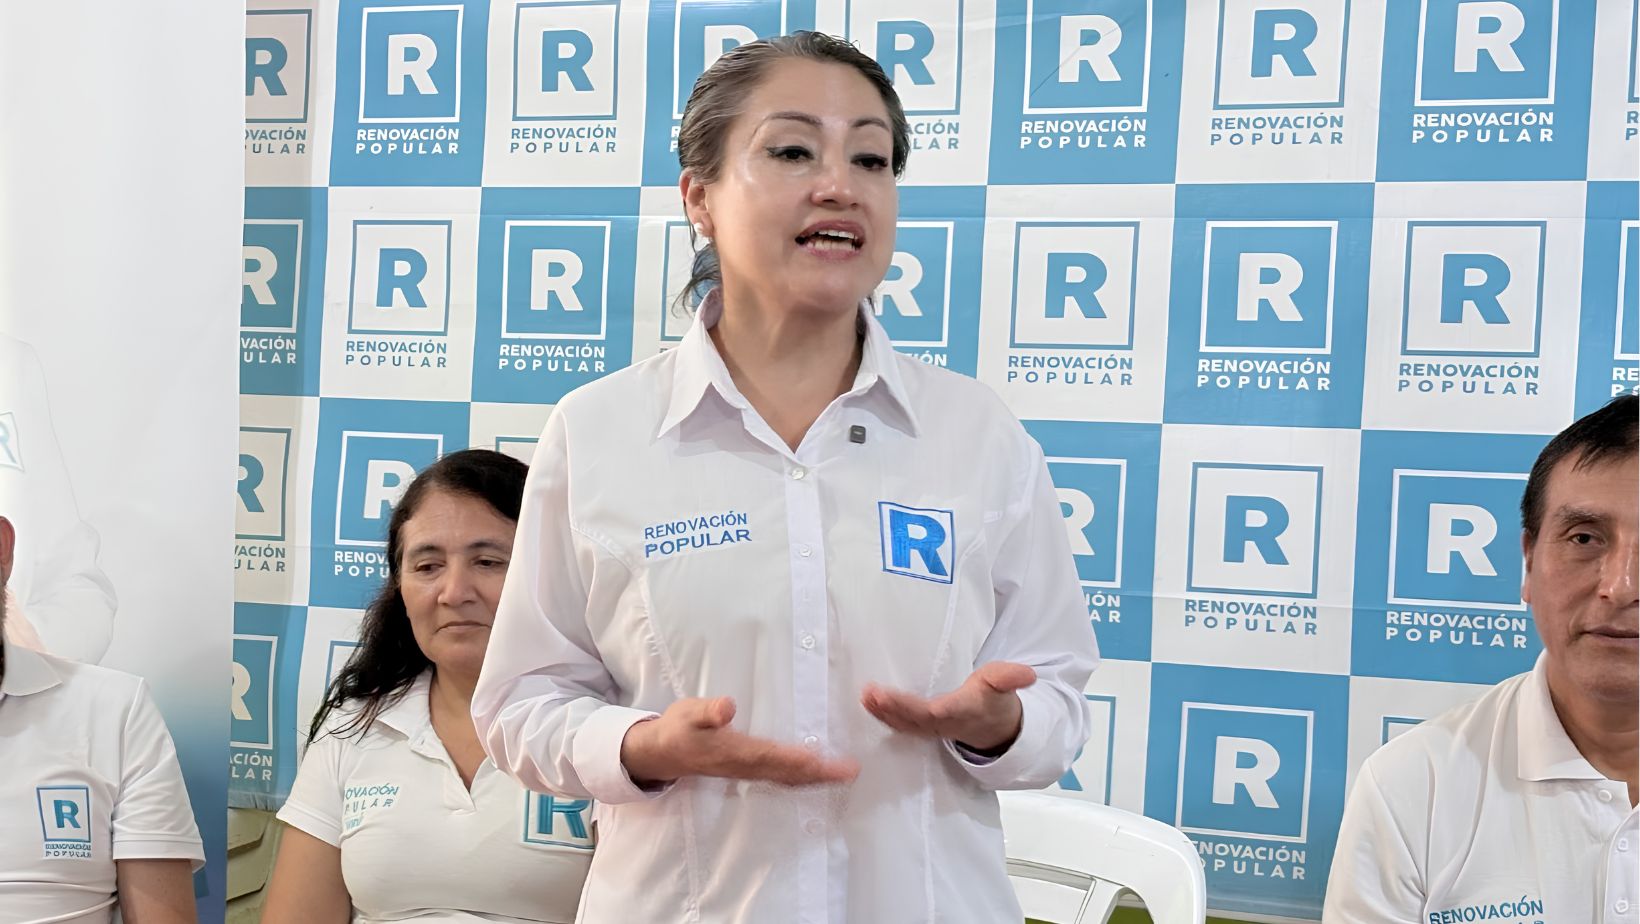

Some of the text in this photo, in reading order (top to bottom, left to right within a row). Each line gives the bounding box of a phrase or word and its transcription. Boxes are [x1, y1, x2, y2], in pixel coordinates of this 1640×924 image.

[1250, 8, 1319, 78] R
[1454, 1, 1526, 73] R
[877, 19, 936, 86] R
[1058, 14, 1123, 83] R
[245, 37, 288, 96] R
[387, 33, 439, 95] R
[541, 29, 595, 93] R
[1020, 116, 1147, 134] RENOVACIÓN
[1211, 112, 1344, 131] RENOVACIÓN
[1412, 108, 1554, 128] RENOVACIÓN
[357, 126, 460, 141] RENOVACIÓN
[511, 124, 618, 140] RENOVACIÓN
[1020, 135, 1146, 149] POPULAR
[1210, 131, 1343, 146] POPULAR
[1412, 128, 1554, 144] POPULAR
[245, 143, 306, 154] ULAR
[356, 142, 460, 155] POPULAR
[510, 140, 617, 154] POPULAR
[375, 247, 428, 309] R
[530, 248, 584, 312] R
[875, 251, 924, 318] R
[1045, 252, 1108, 319] R
[1236, 252, 1304, 322] R
[1440, 253, 1511, 325] R
[346, 338, 447, 354] RENOVACIÓN
[500, 342, 605, 358] RENOVACIÓN
[345, 354, 447, 368] POPULAR
[499, 358, 605, 373] POPULAR
[1008, 354, 1133, 370] RENOVACIÓN
[1197, 357, 1331, 375] RENOVACIÓN
[1399, 362, 1540, 379] RENOVACIÓN
[1007, 371, 1133, 386] POPULAR
[1197, 375, 1330, 391] POPULAR
[1398, 379, 1539, 395] POPULAR
[644, 510, 748, 540] RENOVACIÓN
[1223, 495, 1290, 566] R
[645, 529, 753, 558] POPULAR
[889, 508, 948, 577] R
[1426, 503, 1498, 577] R
[334, 550, 389, 565] RENOV
[1184, 599, 1318, 620] RENOVACIÓN
[1184, 615, 1317, 636] POPULAR
[1386, 611, 1528, 632] RENOVACIÓN
[1386, 627, 1528, 649] POPULAR
[1212, 735, 1281, 809] R
[53, 799, 81, 829] R
[537, 793, 589, 838] R
[1430, 895, 1545, 924] RENOVACIÓN
